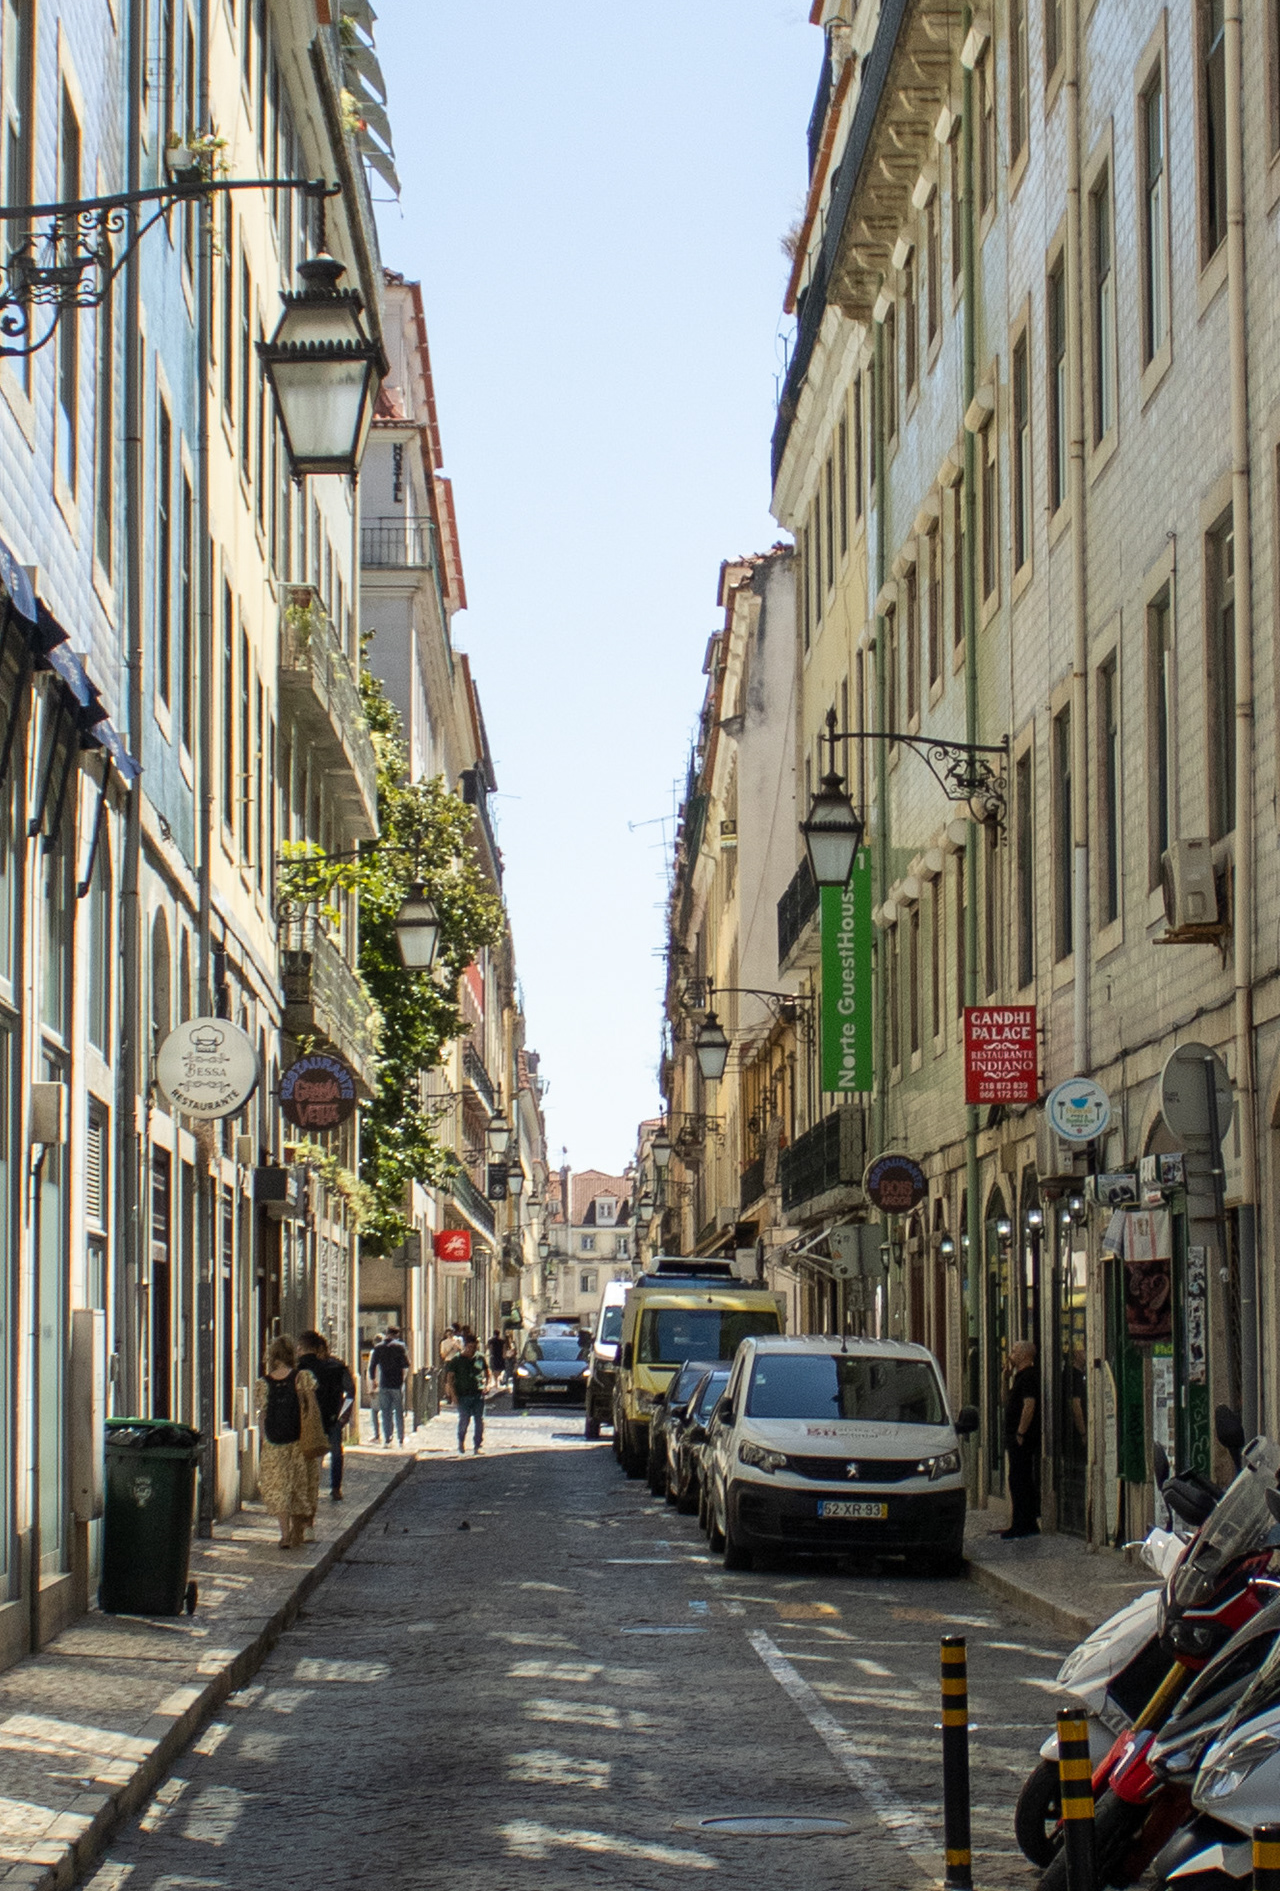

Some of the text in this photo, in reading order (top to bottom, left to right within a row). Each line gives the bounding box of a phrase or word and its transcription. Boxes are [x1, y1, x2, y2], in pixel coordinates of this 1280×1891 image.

[971, 1012, 1031, 1025] GANDHI
[971, 1027, 1031, 1040] PALACE
[838, 1023, 856, 1088] Norte
[971, 1050, 1033, 1060] RESTAURANTE
[971, 1060, 1033, 1071] INDIANO
[281, 1057, 354, 1100] RESTAURANTE
[171, 1089, 240, 1112] RESTAURANTE
